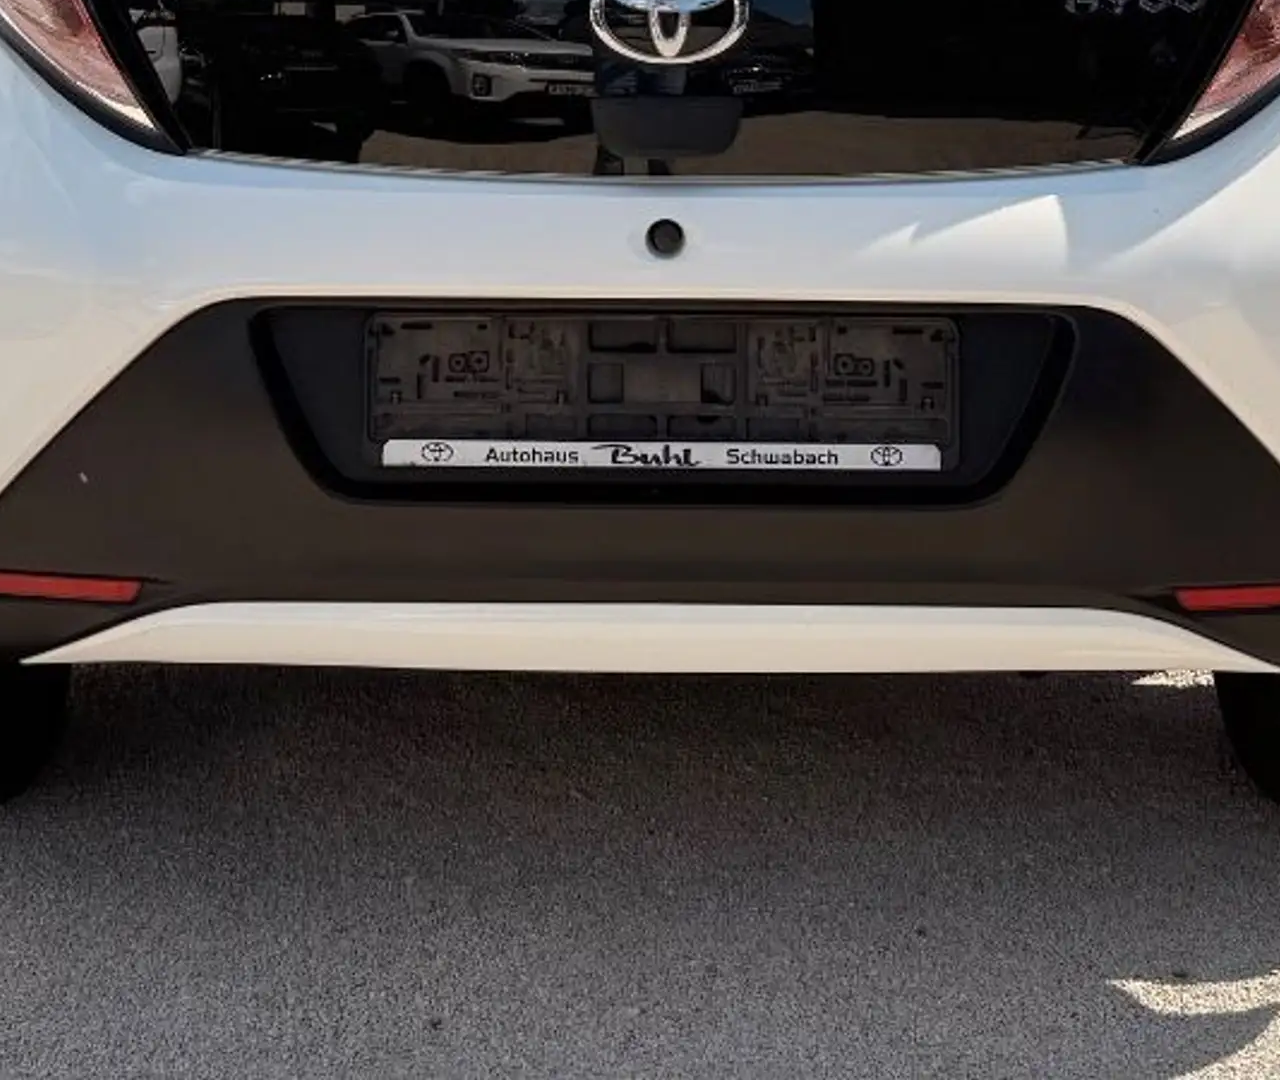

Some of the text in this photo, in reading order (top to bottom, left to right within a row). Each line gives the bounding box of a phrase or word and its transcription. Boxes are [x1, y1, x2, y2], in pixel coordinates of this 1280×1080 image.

[486, 444, 839, 467] Autohaus Buhl Schwabach
